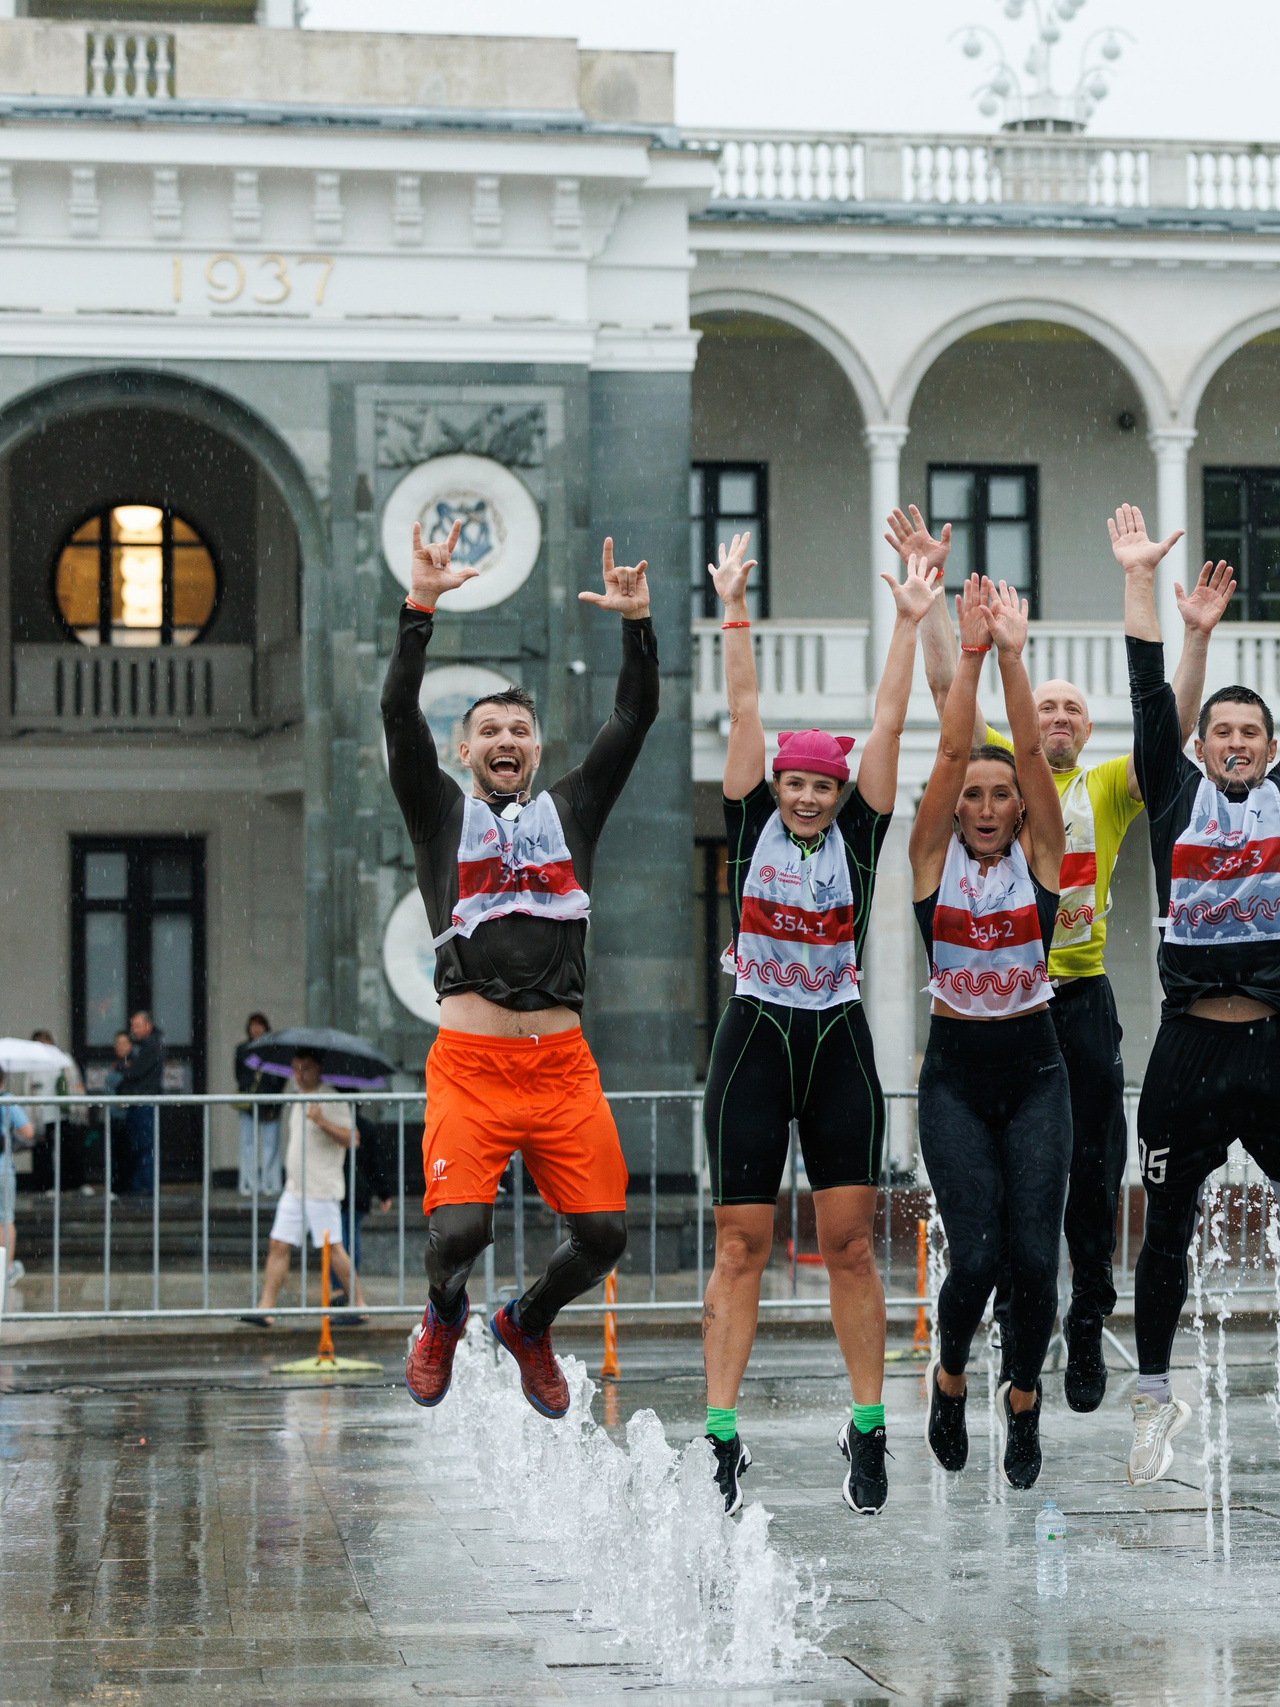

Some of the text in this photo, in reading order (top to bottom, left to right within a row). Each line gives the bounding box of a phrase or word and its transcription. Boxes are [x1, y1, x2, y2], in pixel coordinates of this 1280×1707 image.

[172, 253, 335, 305] 1937
[1210, 850, 1263, 874] 354-3
[499, 866, 550, 883] 34-6
[772, 912, 826, 937] 354-1
[969, 920, 1015, 943] 354-2
